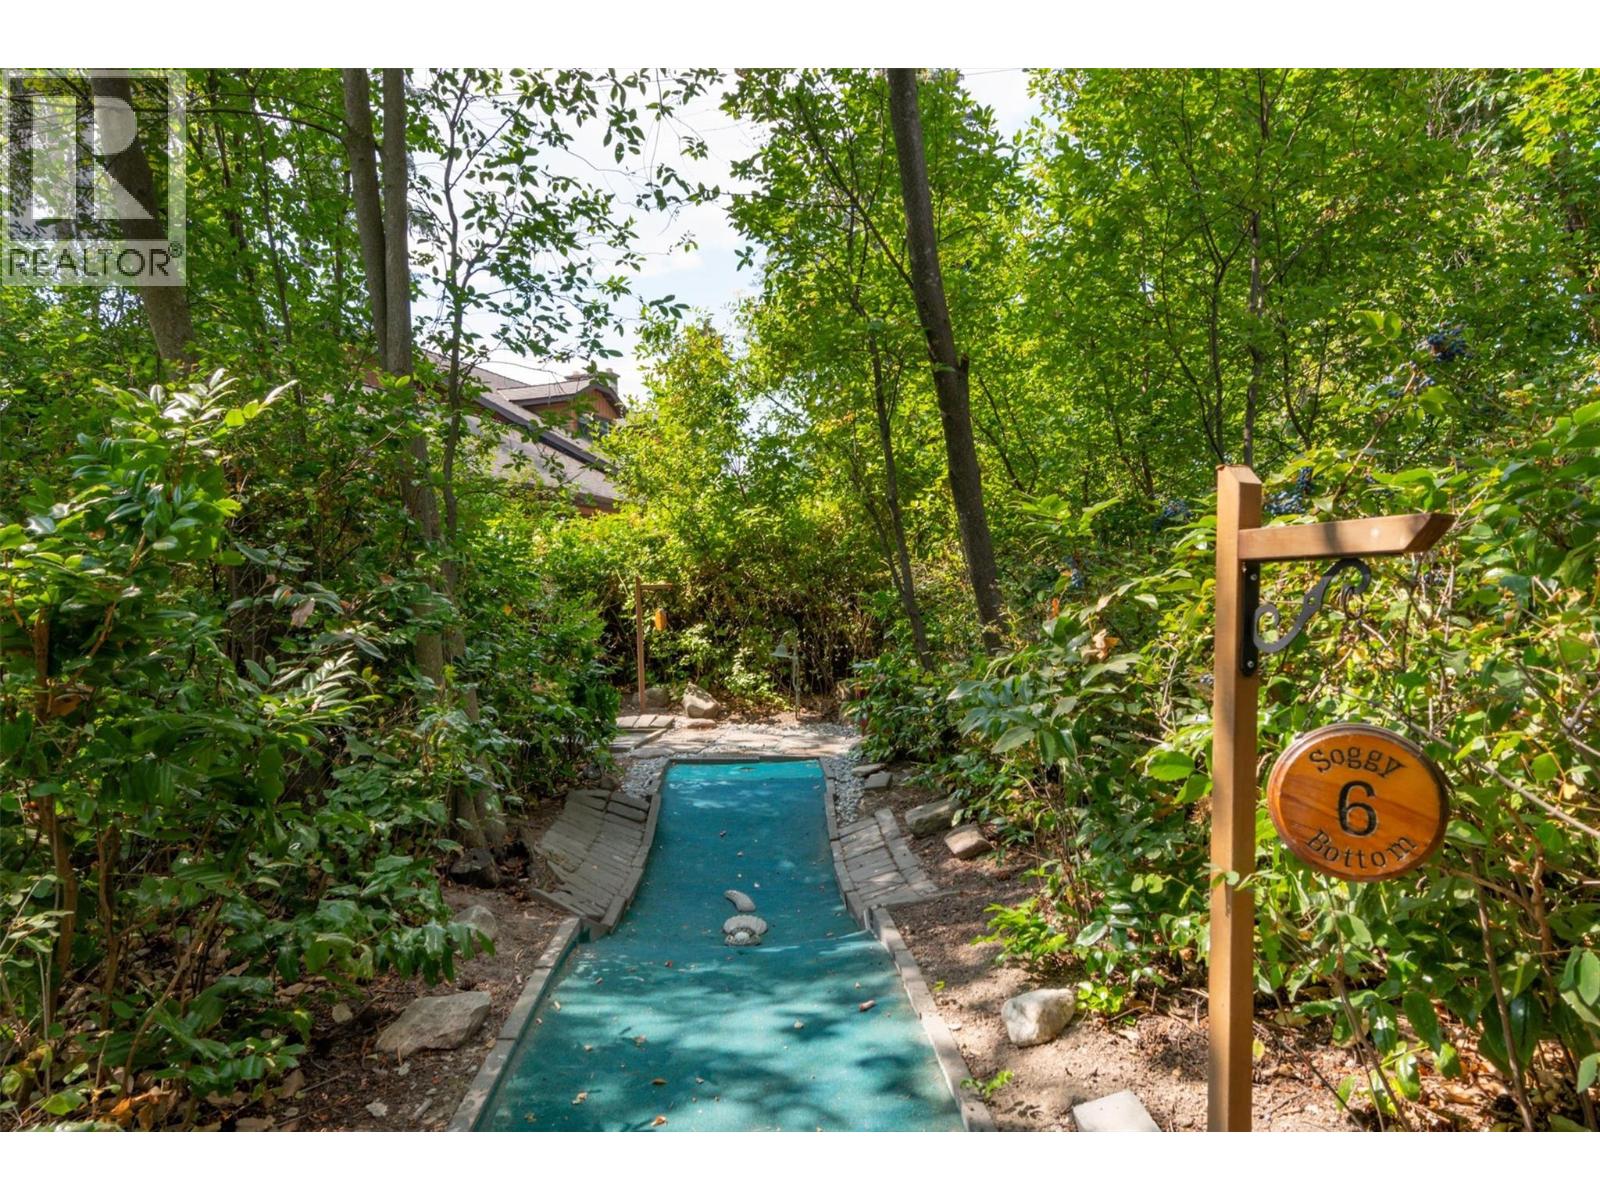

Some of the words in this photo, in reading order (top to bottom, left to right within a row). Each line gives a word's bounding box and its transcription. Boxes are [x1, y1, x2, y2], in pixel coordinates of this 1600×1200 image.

[1309, 747, 1406, 778] Soggy
[1338, 780, 1378, 837] 6
[1306, 829, 1418, 869] Bottom
